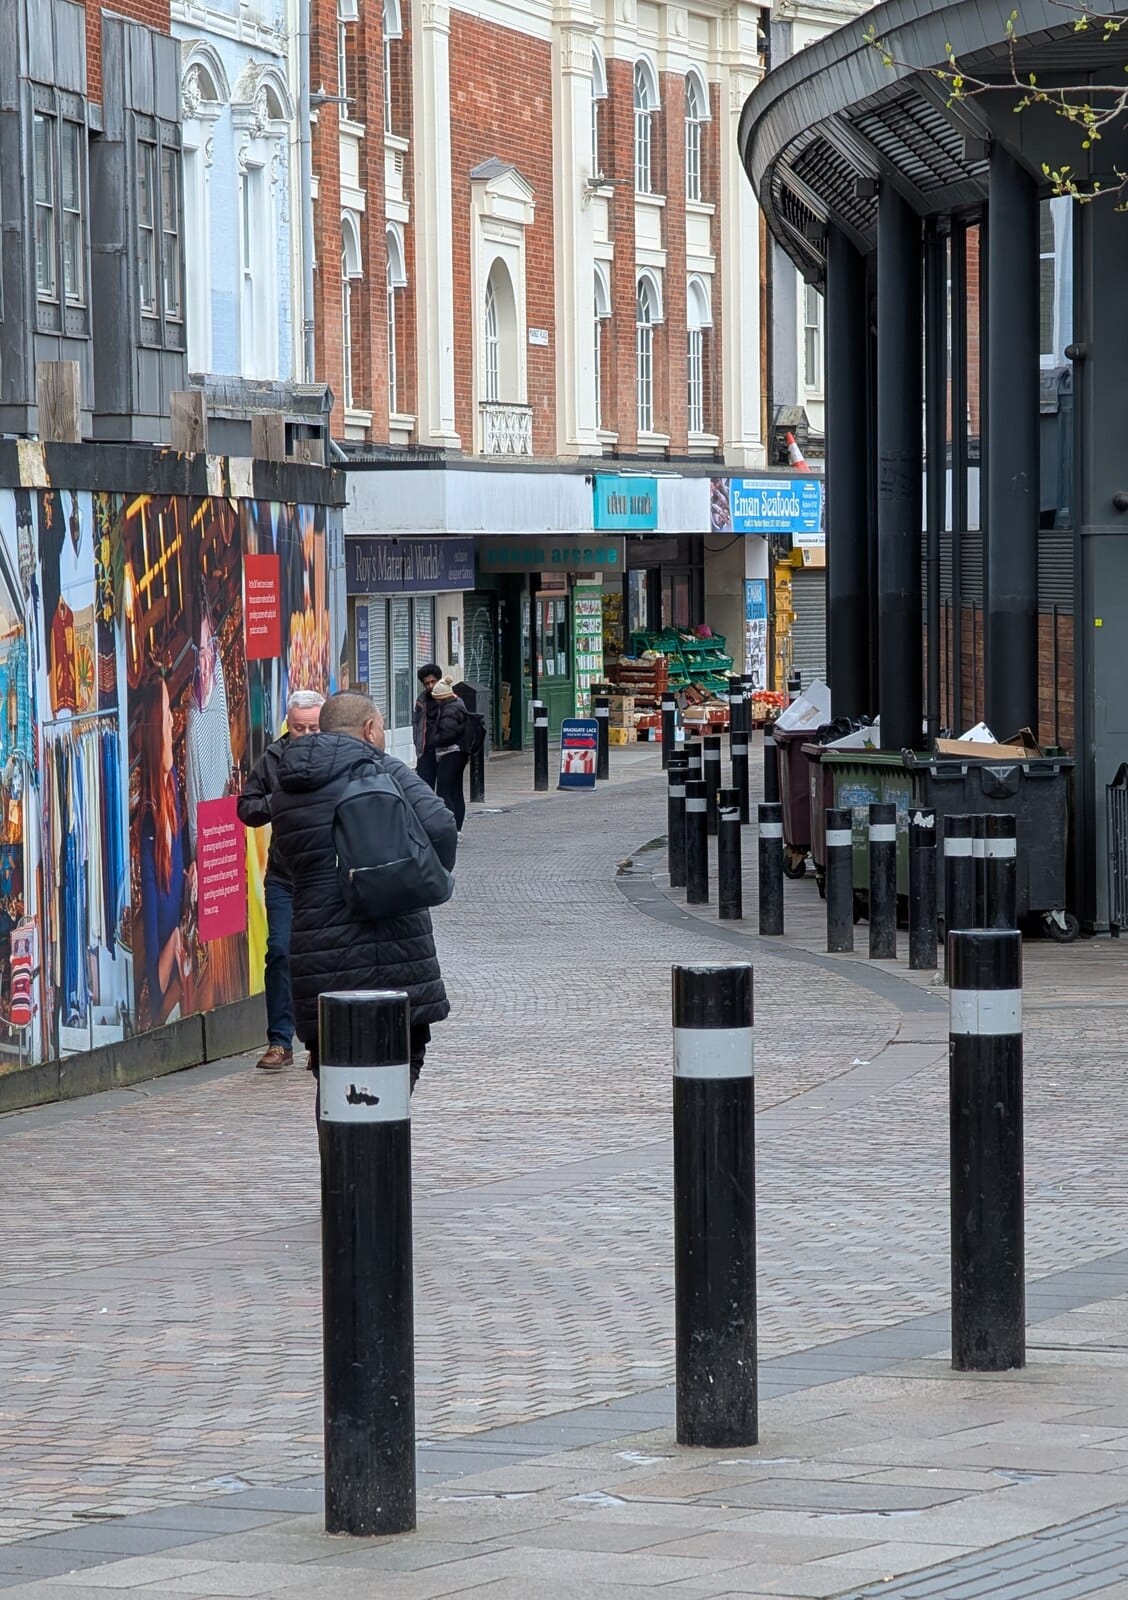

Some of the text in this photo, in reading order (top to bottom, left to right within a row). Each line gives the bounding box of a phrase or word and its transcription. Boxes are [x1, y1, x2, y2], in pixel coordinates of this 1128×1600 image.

[733, 491, 799, 517] Eman Seafoods
[355, 543, 439, 591] Roy's Material World
[550, 548, 618, 564] arcade
